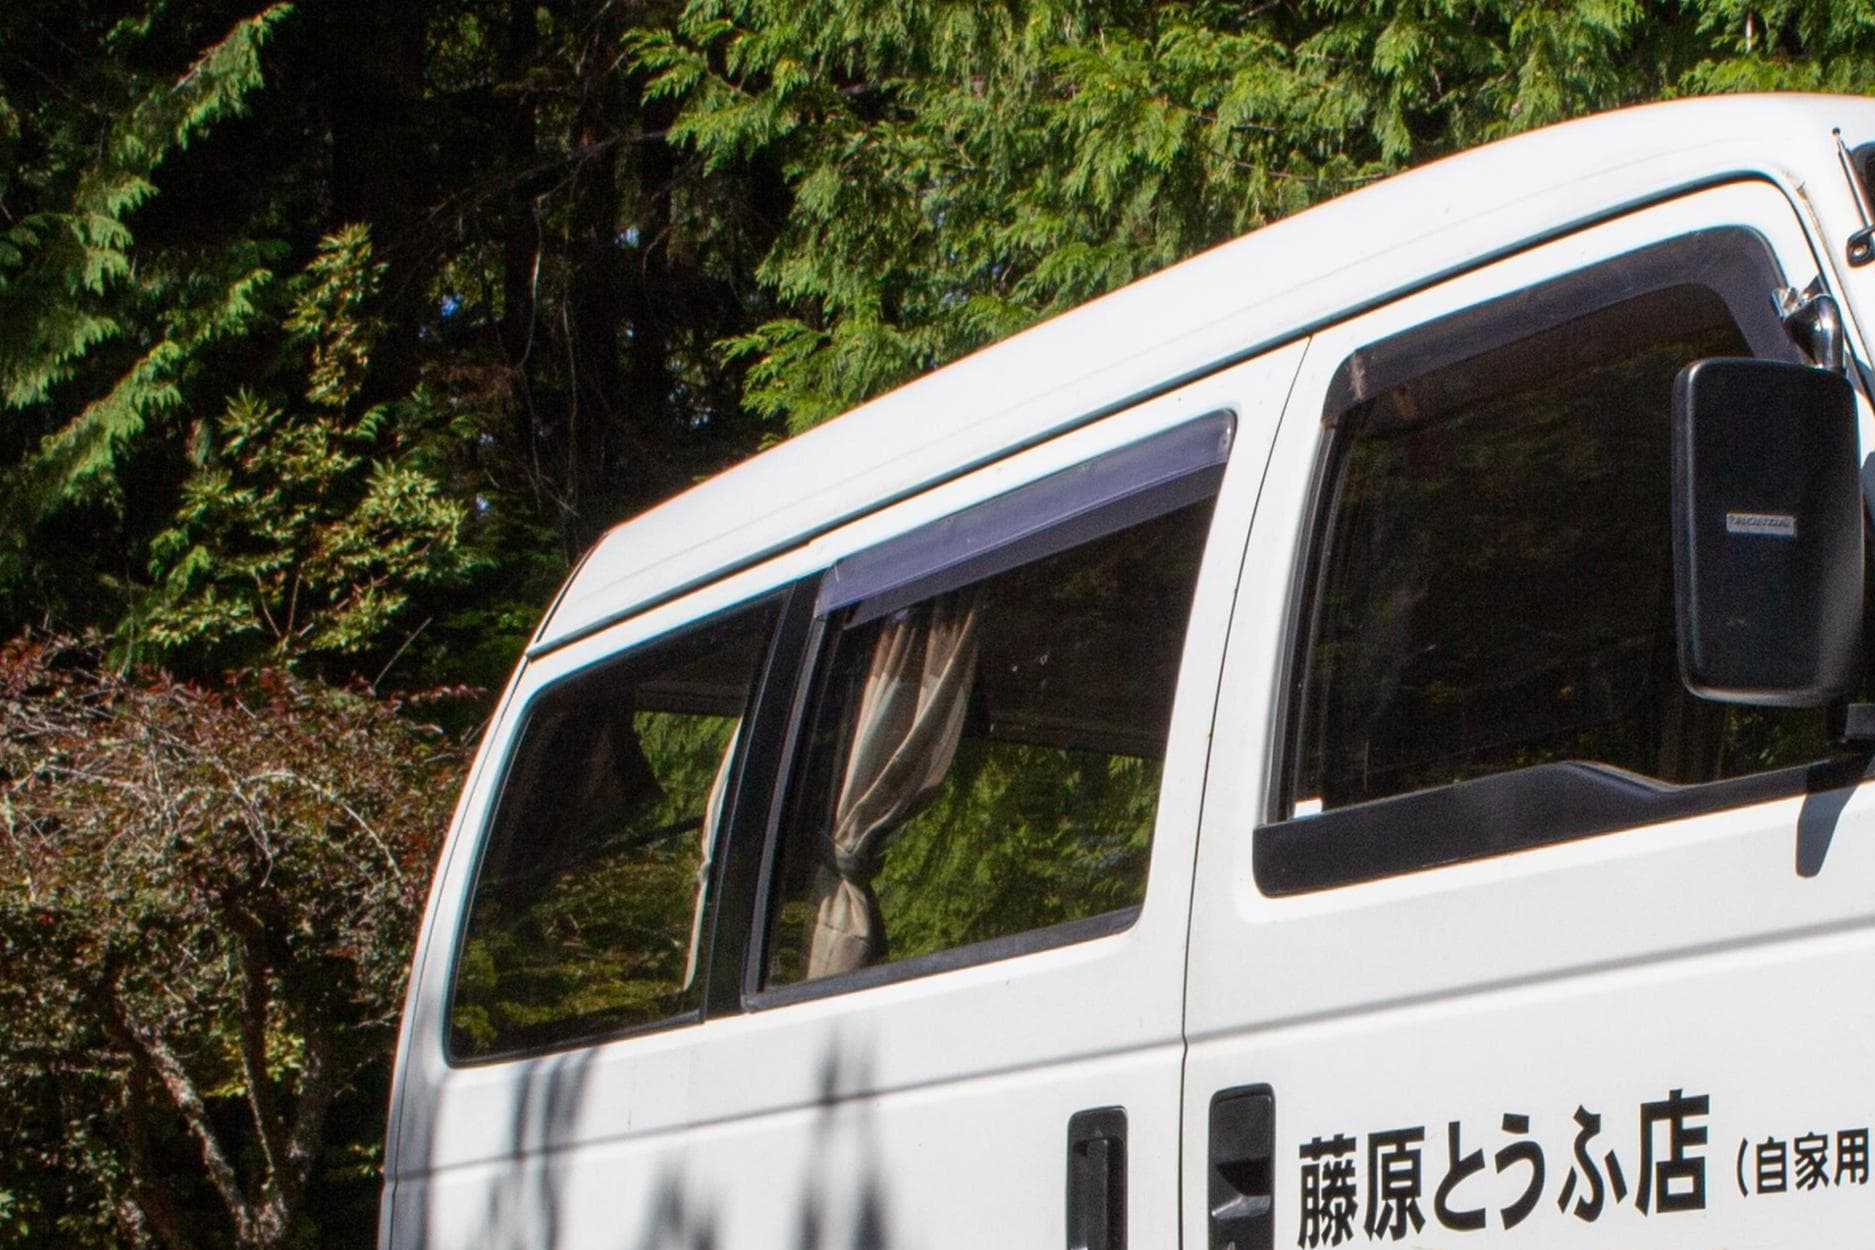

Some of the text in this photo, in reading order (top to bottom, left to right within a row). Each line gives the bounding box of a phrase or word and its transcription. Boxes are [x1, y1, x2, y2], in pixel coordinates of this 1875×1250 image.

[1297, 1088, 1709, 1250] 藤原とうふ店
